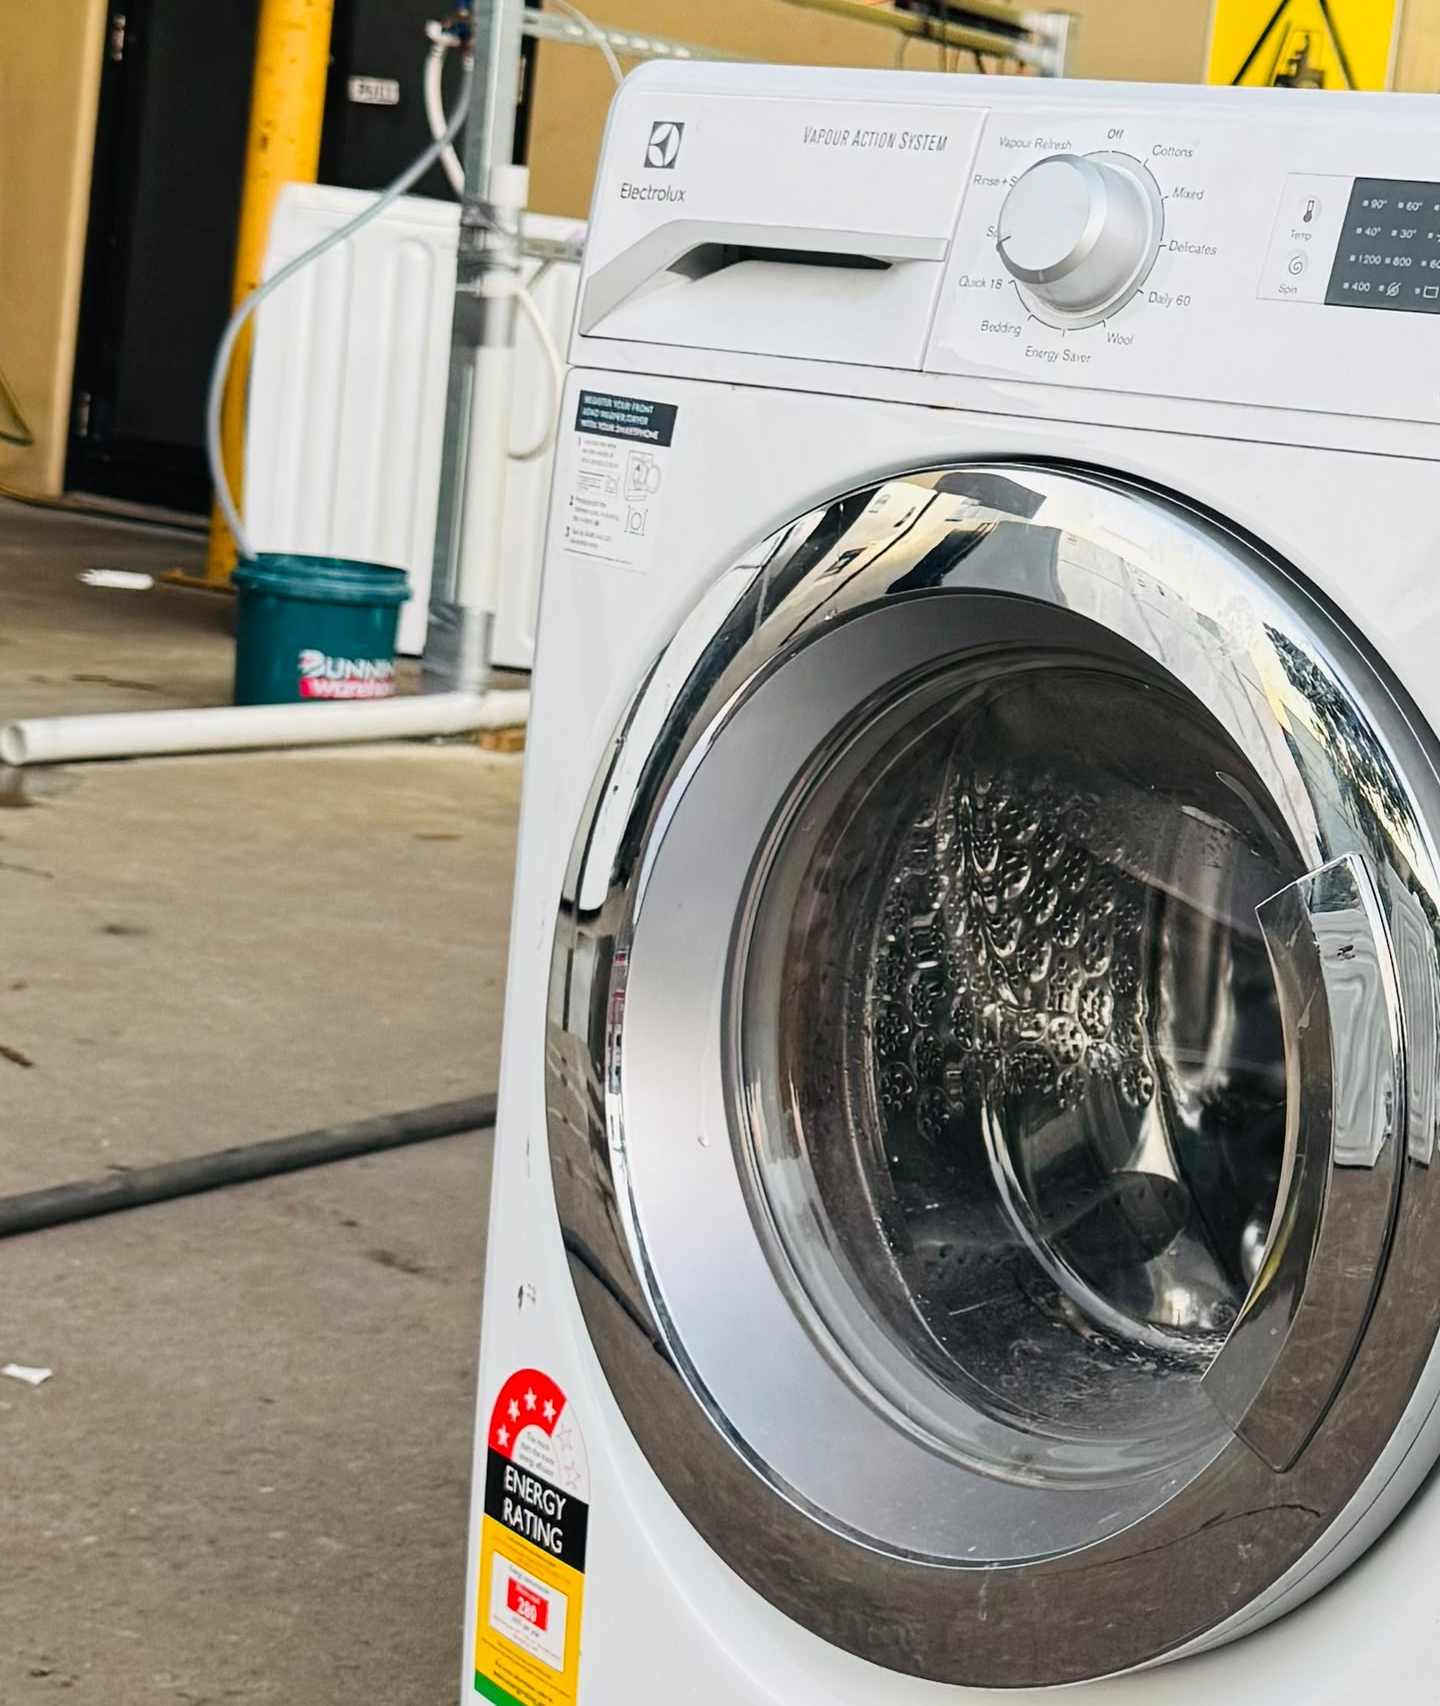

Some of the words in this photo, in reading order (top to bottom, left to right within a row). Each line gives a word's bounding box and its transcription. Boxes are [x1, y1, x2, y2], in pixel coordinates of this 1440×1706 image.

[802, 125, 850, 146] VAPOUR
[851, 129, 896, 149] ACTION
[898, 131, 948, 152] SYSTEM
[1107, 128, 1125, 140] Off
[1000, 136, 1032, 150] Vapour
[1034, 137, 1072, 151] Refresh
[1151, 144, 1194, 159] Cottons
[973, 174, 1000, 186] Rinse
[620, 182, 686, 203] Electrolux
[1173, 187, 1205, 201] Mixed
[1169, 240, 1218, 256] Delicates
[1358, 254, 1381, 265] 1200
[1392, 256, 1412, 267] 800
[958, 275, 986, 290] Quick
[990, 278, 1003, 290] 18
[1278, 283, 1298, 295] Spin
[1352, 281, 1371, 292] 400
[1148, 291, 1174, 308] Daily
[1176, 294, 1192, 307] 60
[980, 320, 1022, 337] Bedding
[1107, 332, 1134, 345] Wool
[1025, 345, 1060, 362] Energy
[1062, 348, 1092, 363] Saver
[504, 1464, 567, 1522] ENERGY
[503, 1497, 563, 1554] RATING
[516, 1596, 537, 1623] 280
